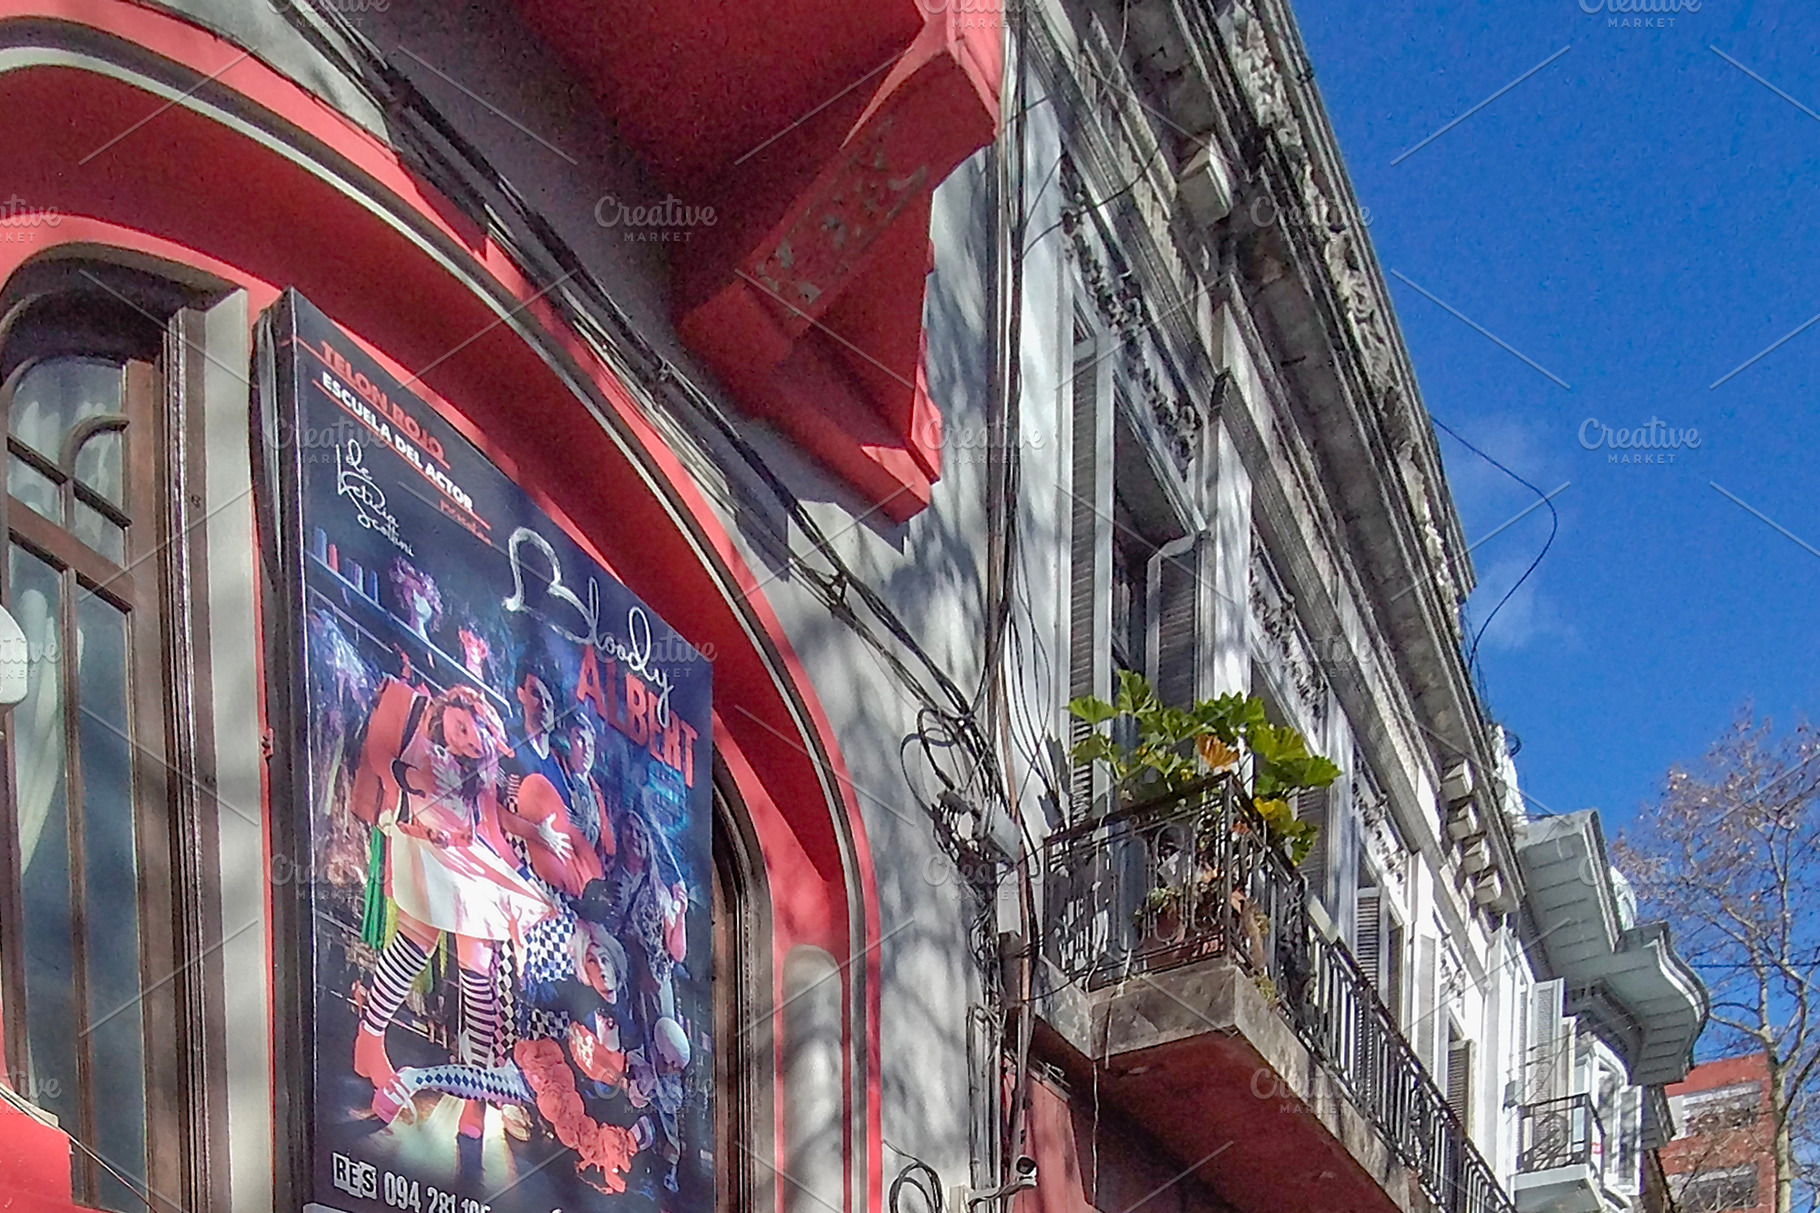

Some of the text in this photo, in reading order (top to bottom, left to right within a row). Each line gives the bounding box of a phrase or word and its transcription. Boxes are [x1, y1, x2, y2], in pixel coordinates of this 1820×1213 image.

[321, 371, 475, 512] ESCUELA DEL ACTOR
[391, 402, 446, 461] ROJO
[502, 525, 674, 728] Bloody
[577, 643, 699, 790] ALBERT
[333, 1154, 377, 1198] RES
[384, 1171, 422, 1213] 094
